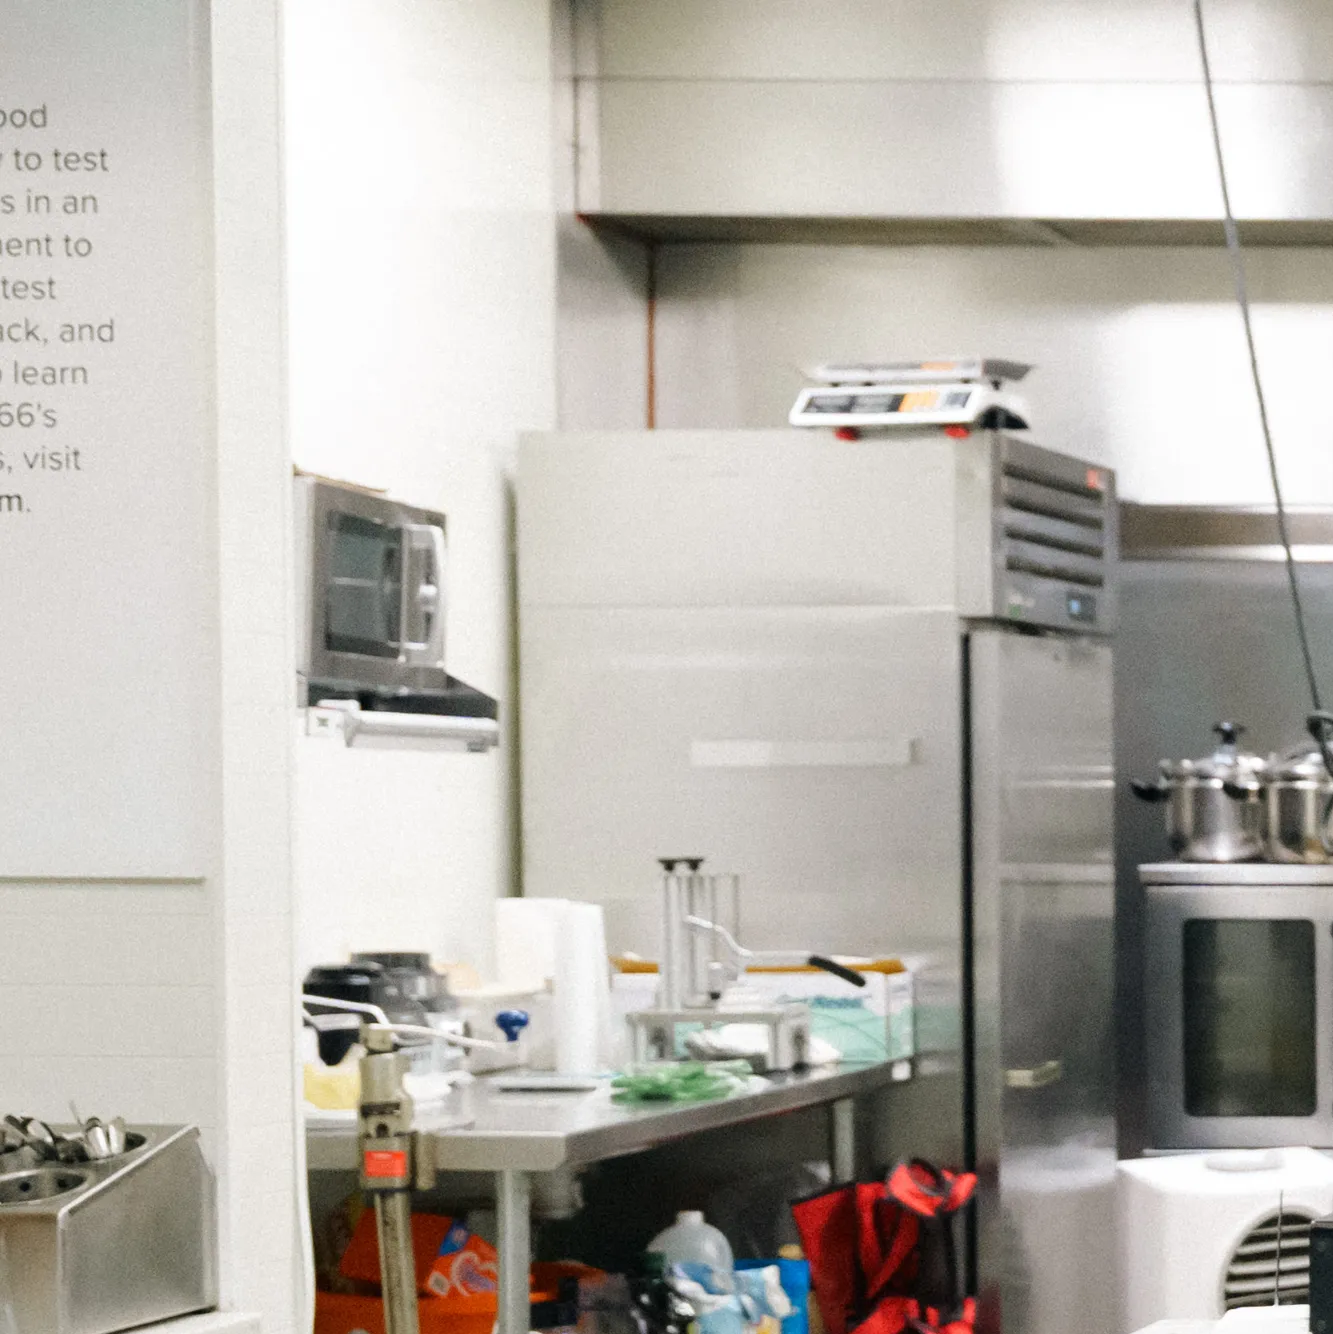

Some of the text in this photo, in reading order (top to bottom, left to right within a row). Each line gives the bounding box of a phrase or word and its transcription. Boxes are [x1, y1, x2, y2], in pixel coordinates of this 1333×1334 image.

[14, 148, 109, 172] to test
[27, 187, 50, 213] in
[63, 194, 98, 214] an
[0, 234, 92, 257] ent to
[1, 276, 56, 300] test
[0, 317, 115, 345] ck, and
[14, 359, 88, 385] learn
[23, 445, 81, 470] visit
